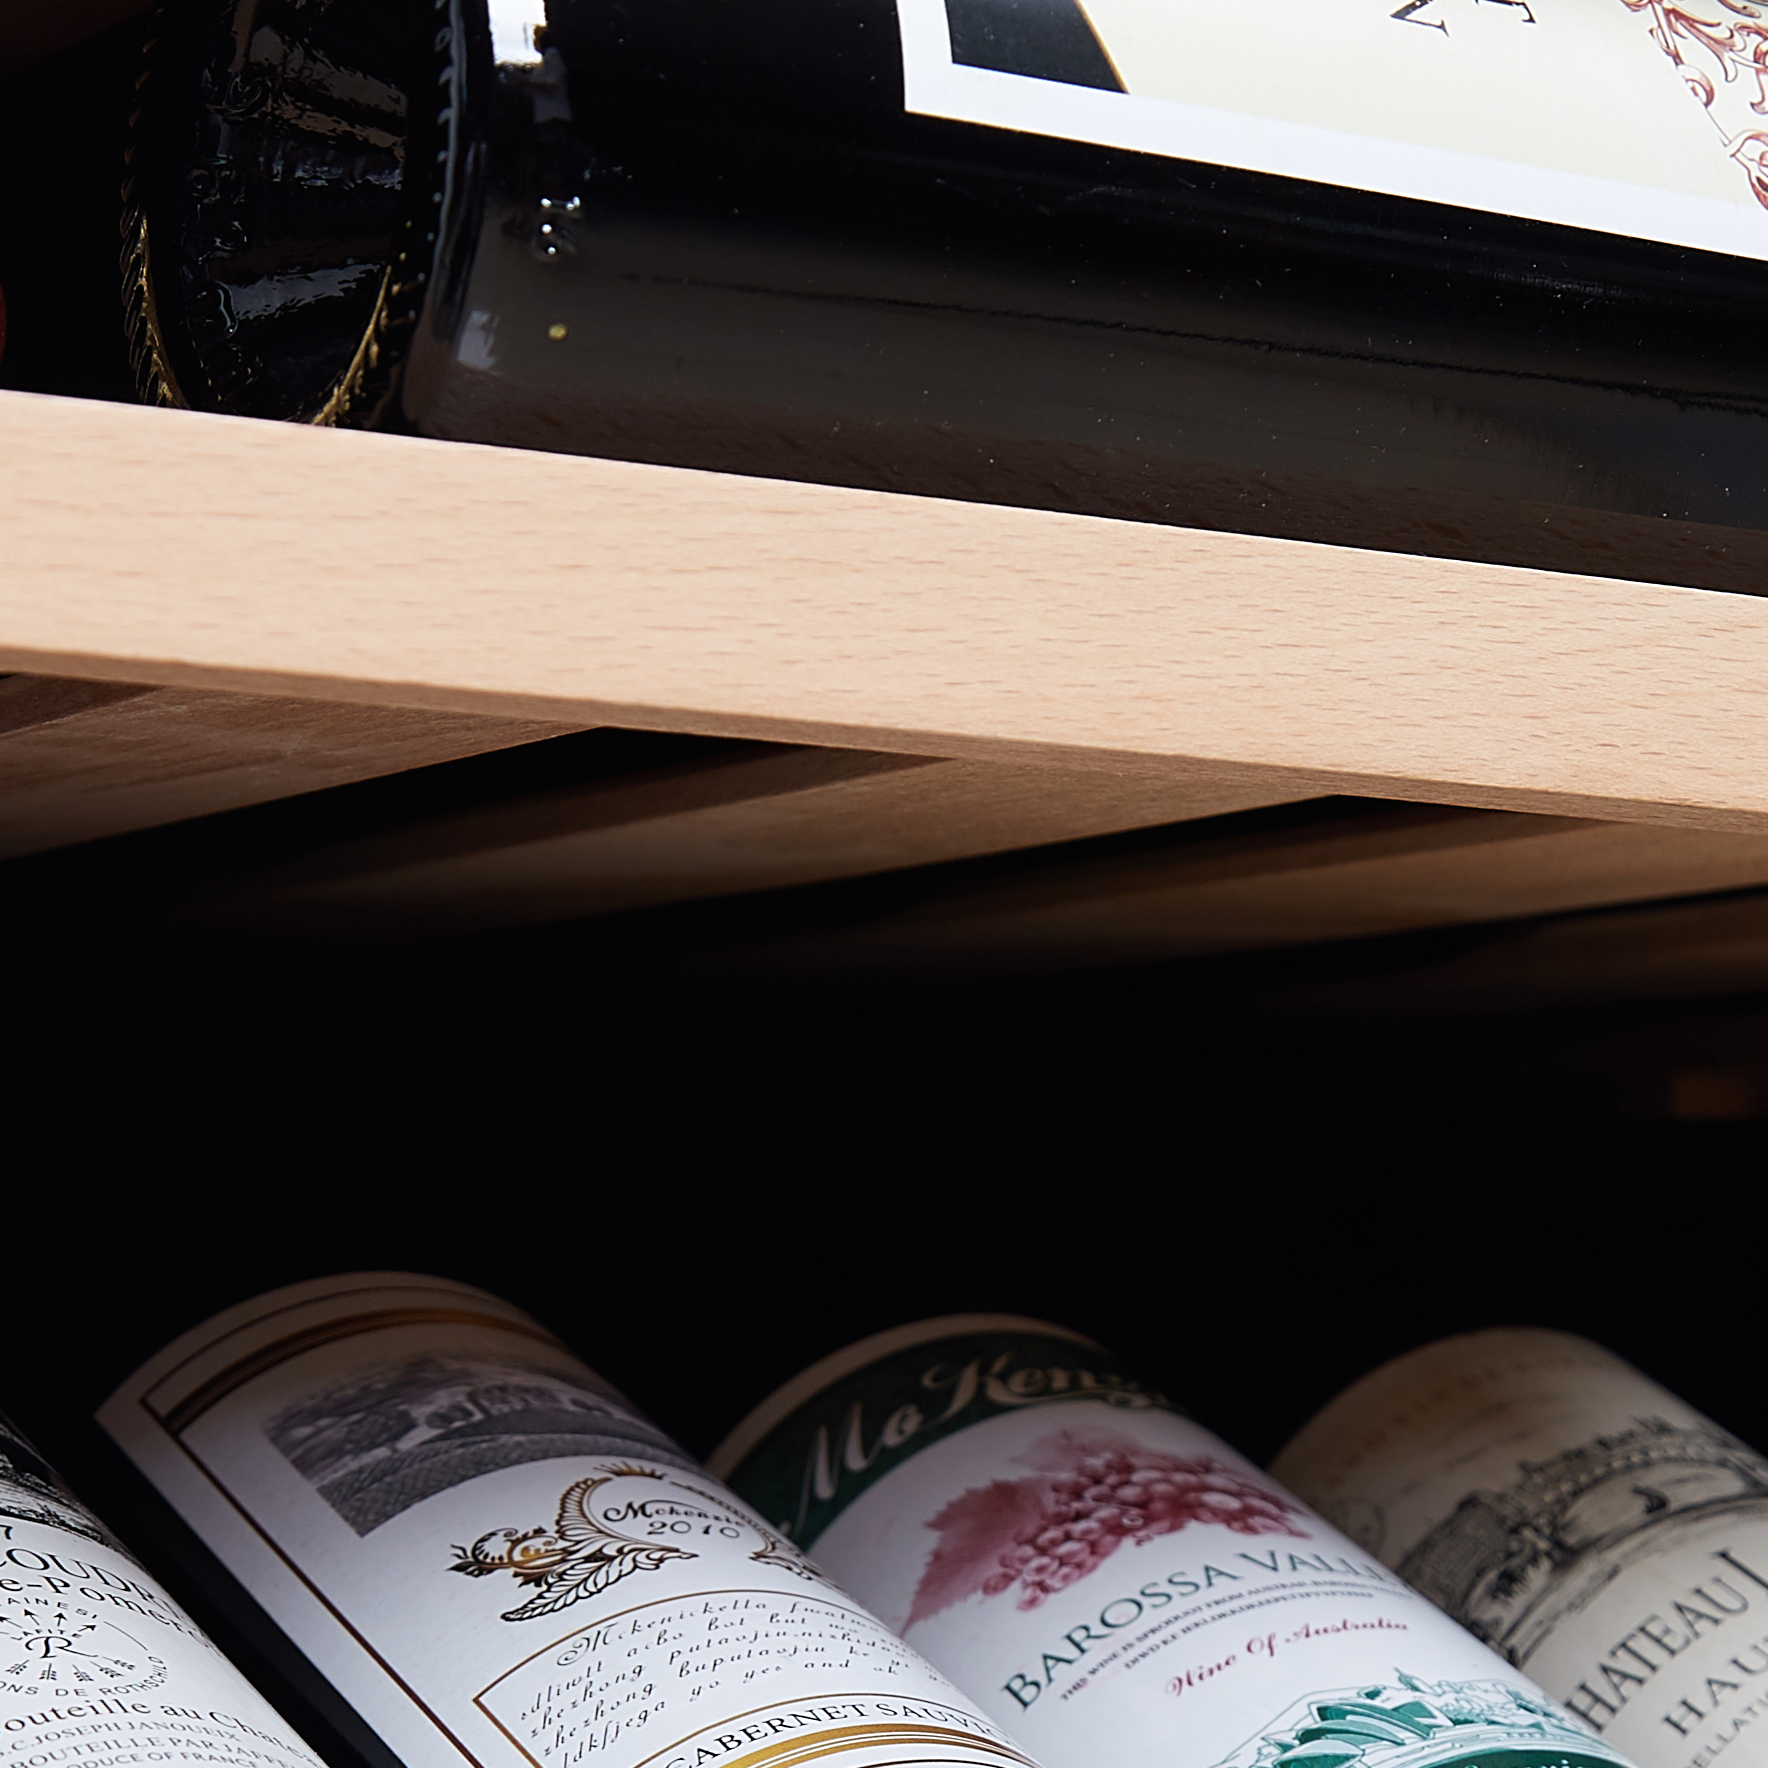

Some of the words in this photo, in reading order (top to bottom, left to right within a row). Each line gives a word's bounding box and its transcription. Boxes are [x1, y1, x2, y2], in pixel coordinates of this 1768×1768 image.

[646, 1521, 741, 1539] 2010
[10, 1628, 82, 1641] LAFITE
[1000, 1563, 1245, 1712] BAROSSA
[1234, 1549, 1404, 1588] VALLE
[1165, 1654, 1237, 1697] Wine
[1246, 1632, 1278, 1657] Of
[1285, 1617, 1410, 1643] Australia
[1564, 1576, 1750, 1735] HATEAU
[55, 1688, 89, 1698] DE
[102, 1655, 169, 1697] ROTHSCHILD
[159, 1703, 205, 1721] au
[168, 1737, 222, 1752] PAR
[147, 1751, 174, 1761] OF
